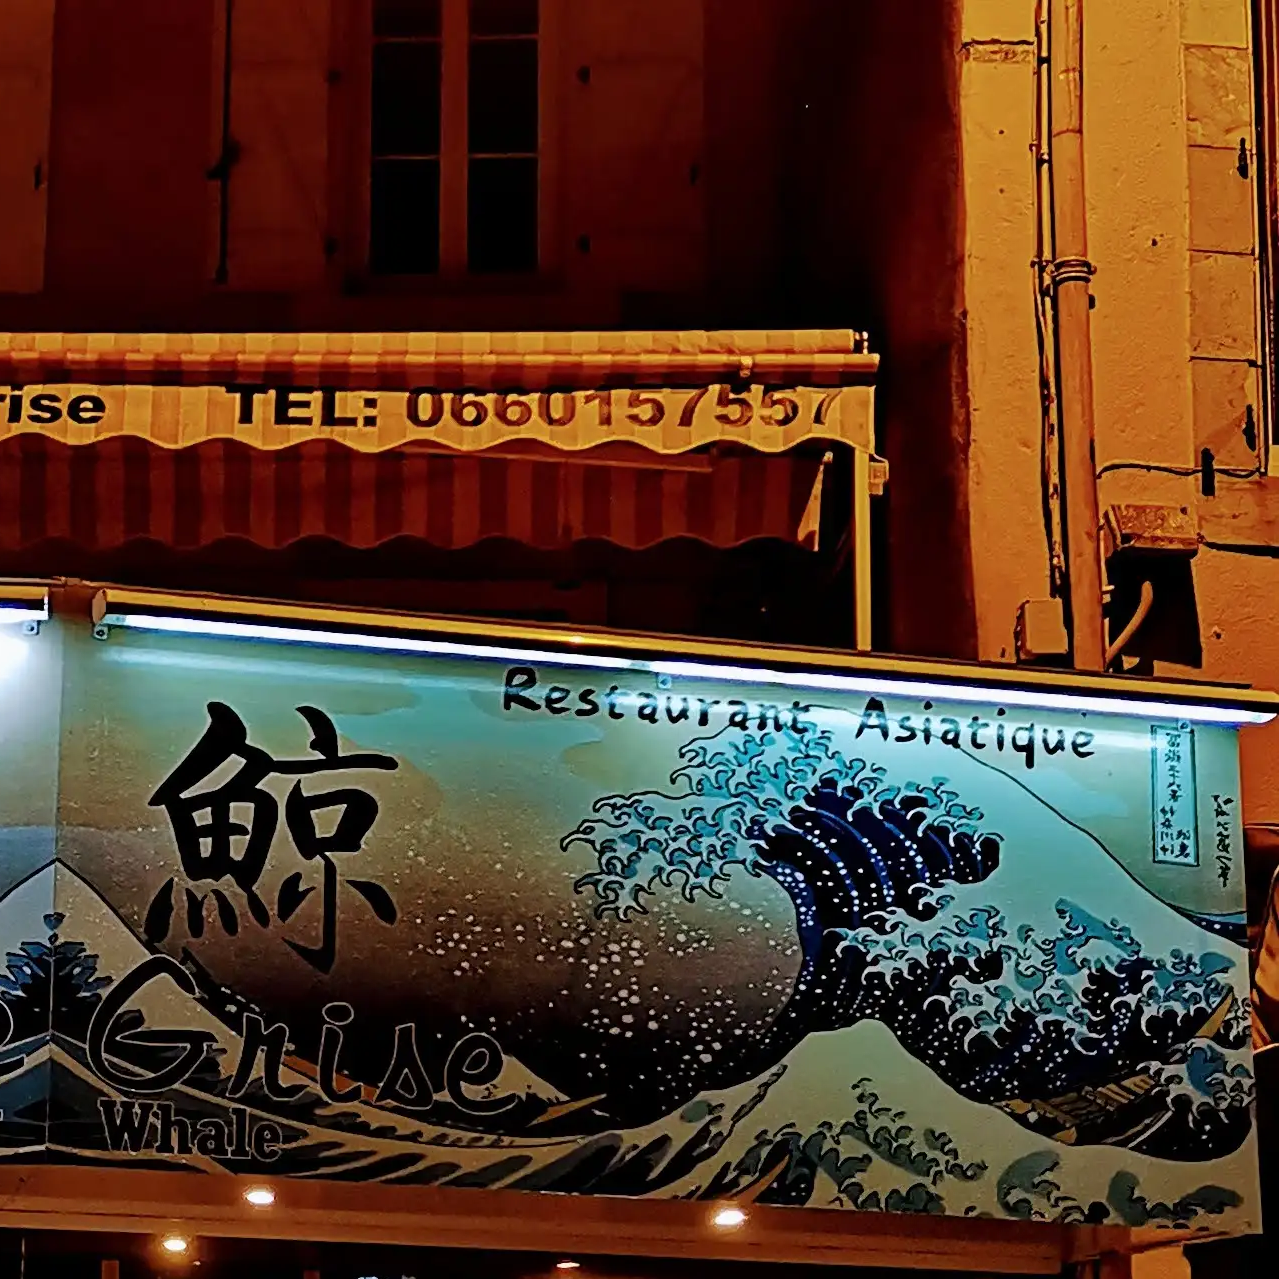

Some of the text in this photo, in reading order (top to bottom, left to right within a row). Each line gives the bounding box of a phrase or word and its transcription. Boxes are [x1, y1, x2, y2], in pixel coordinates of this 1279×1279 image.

[225, 384, 378, 427] TEL:
[405, 384, 843, 428] 0660157557
[503, 666, 811, 734] Restaurant
[855, 696, 1096, 769] Asiatique
[144, 701, 399, 974] 鯨
[87, 954, 519, 1116] Grise
[97, 1097, 282, 1161] Whale
